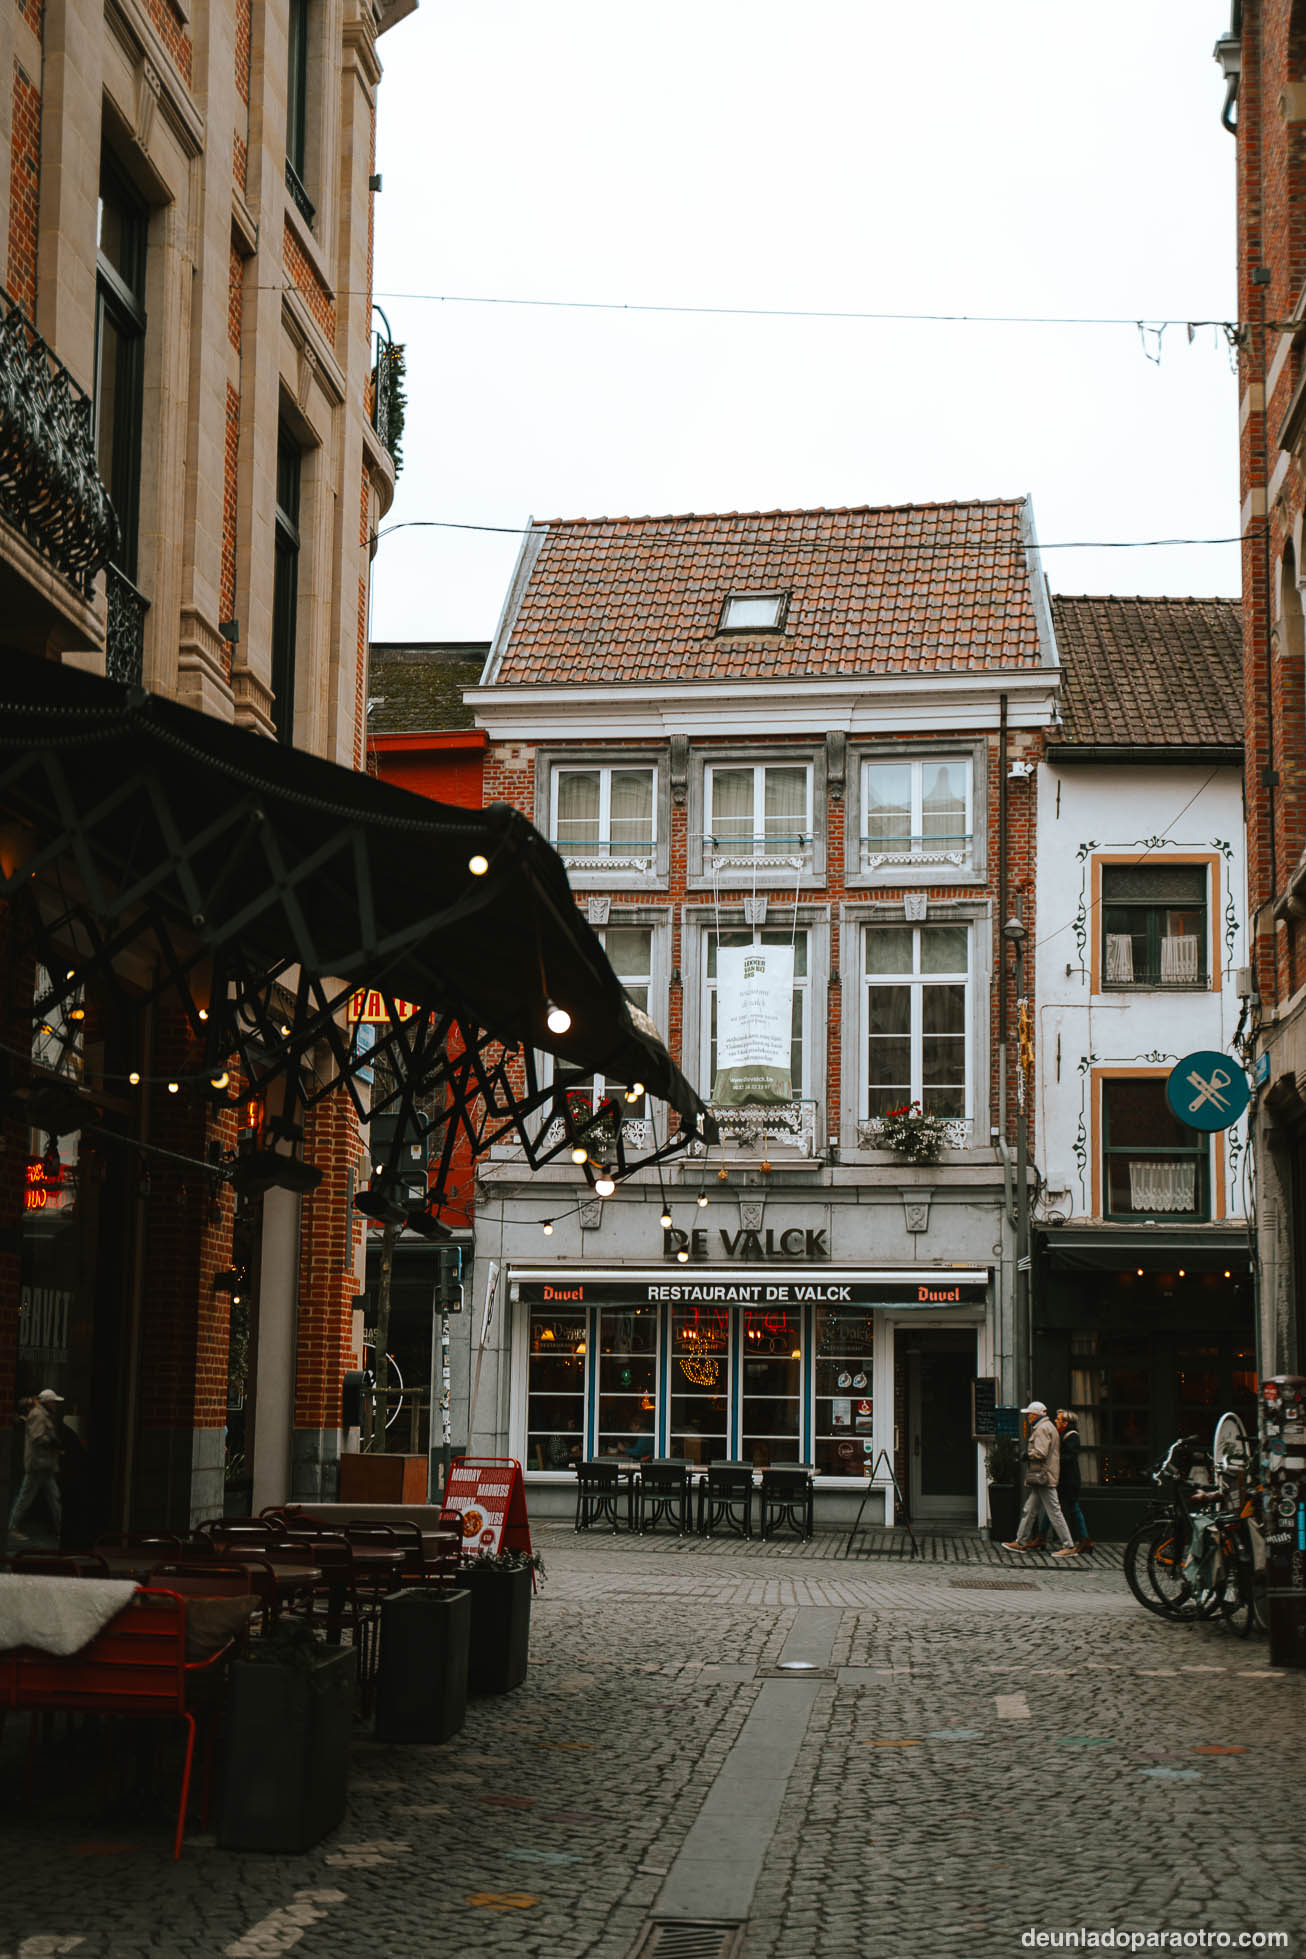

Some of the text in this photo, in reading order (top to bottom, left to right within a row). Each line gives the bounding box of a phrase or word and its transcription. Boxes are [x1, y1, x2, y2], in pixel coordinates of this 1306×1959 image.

[719, 1229, 828, 1256] VALCK
[543, 1286, 584, 1300] Duvel
[648, 1287, 851, 1300] RESTAURANT DE VALCK
[918, 1286, 961, 1301] Duvel
[451, 1469, 481, 1482] MONDAY
[477, 1484, 510, 1497] MADNESS
